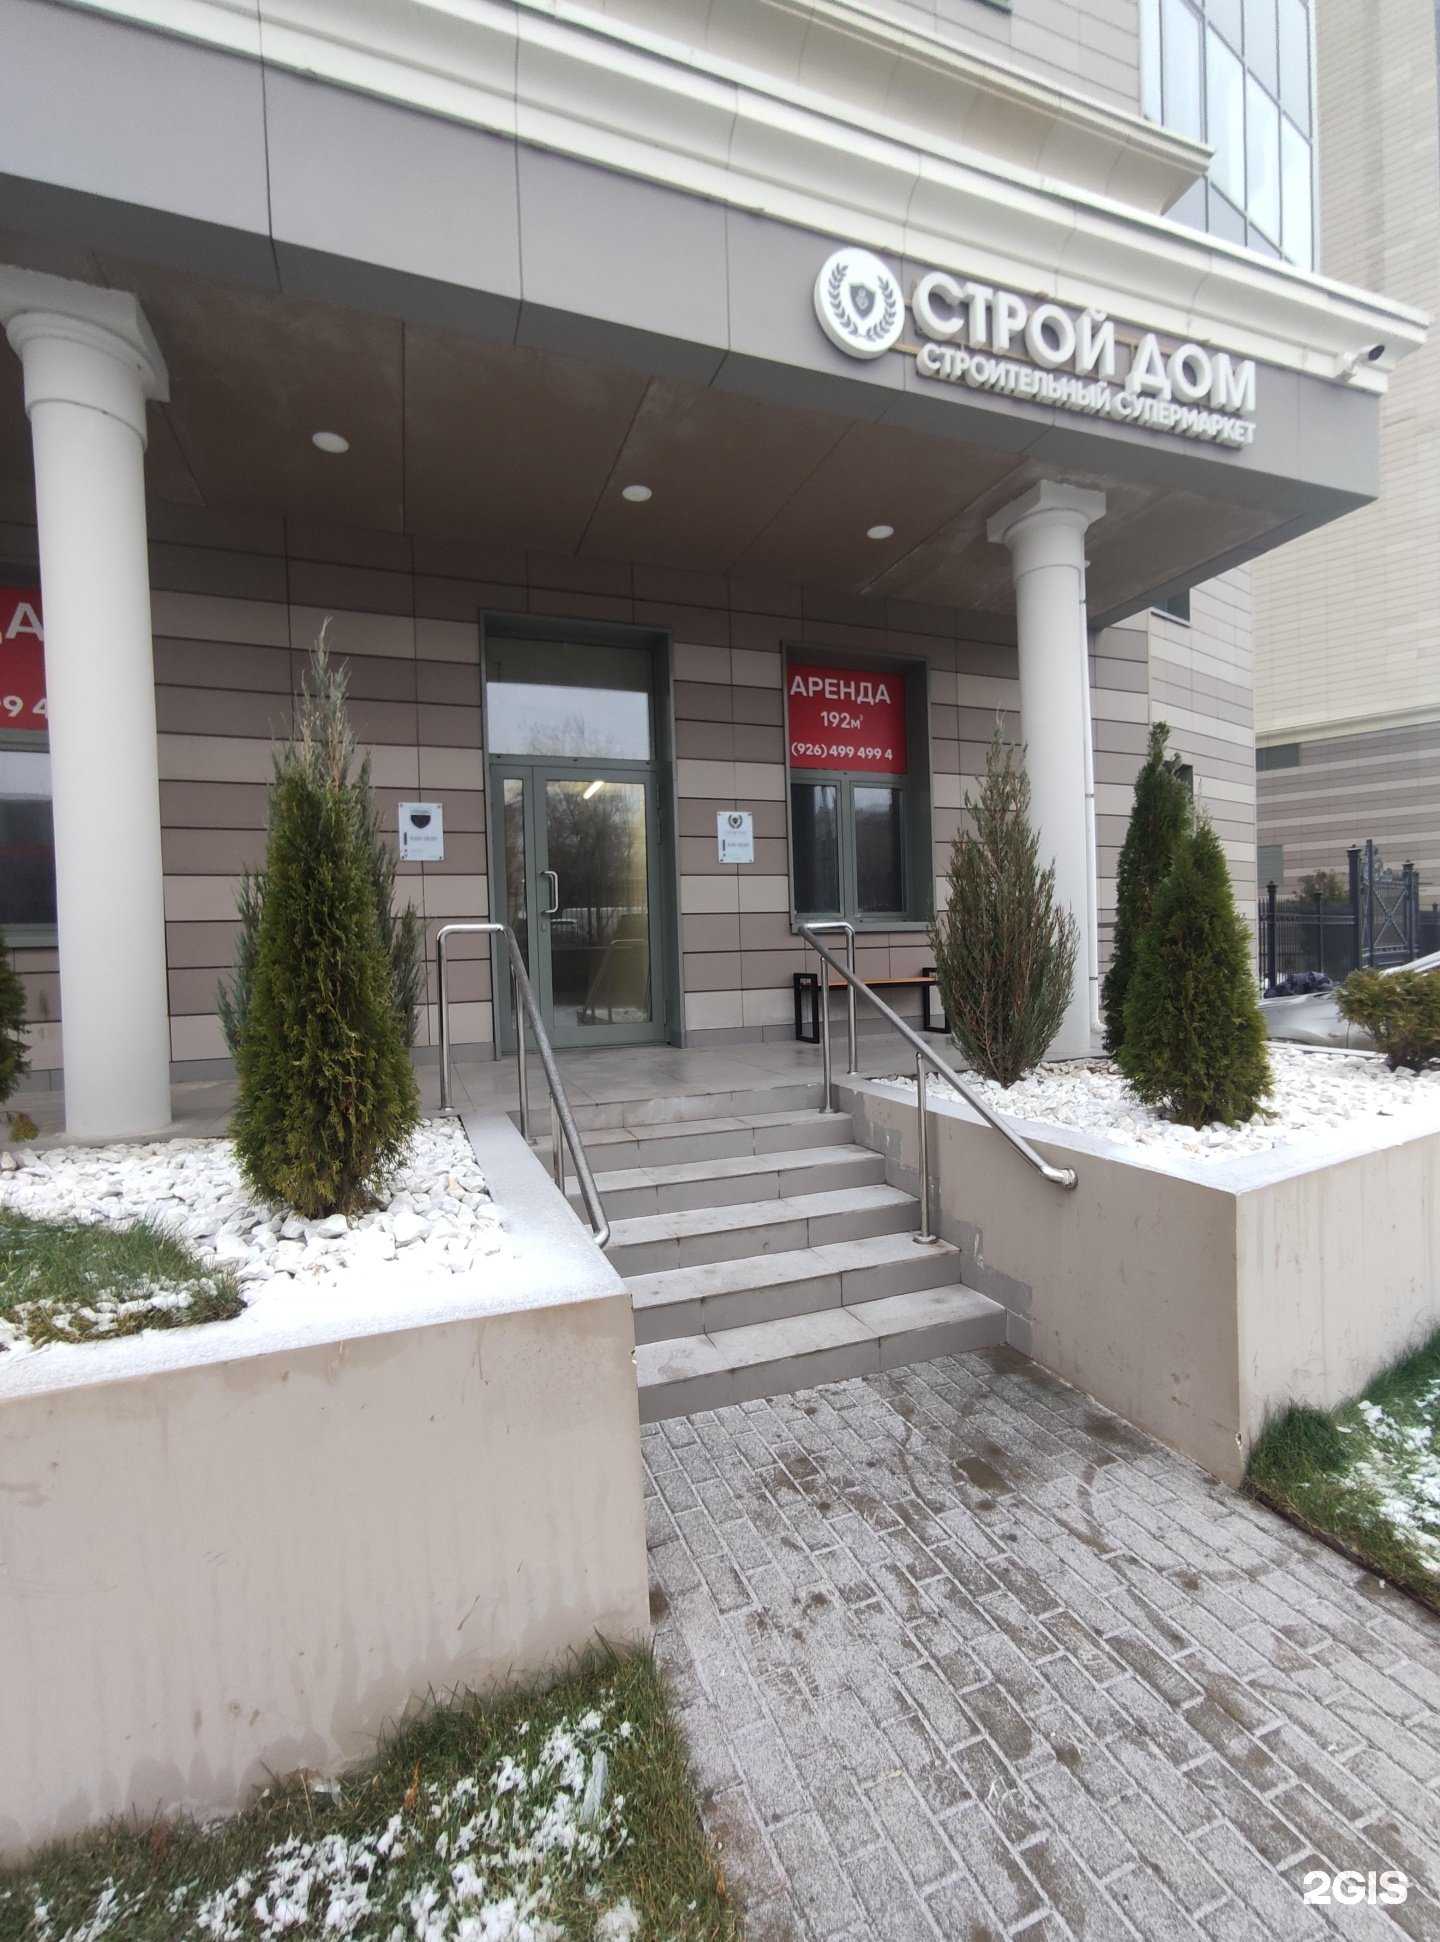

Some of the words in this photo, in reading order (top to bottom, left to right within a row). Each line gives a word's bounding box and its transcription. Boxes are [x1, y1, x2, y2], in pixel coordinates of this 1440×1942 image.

[912, 271, 1115, 377] СТРОЙ
[1125, 333, 1256, 412] ДОМ
[916, 343, 1111, 412] СТРОИТЕЛЬНЫЙ
[1112, 391, 1256, 446] СУПЕРМАРКЕТ
[790, 675, 891, 706] АРЕНДА
[791, 742, 828, 759] (926)
[829, 745, 855, 758] 499
[857, 747, 882, 760] 499
[884, 749, 893, 761] 4
